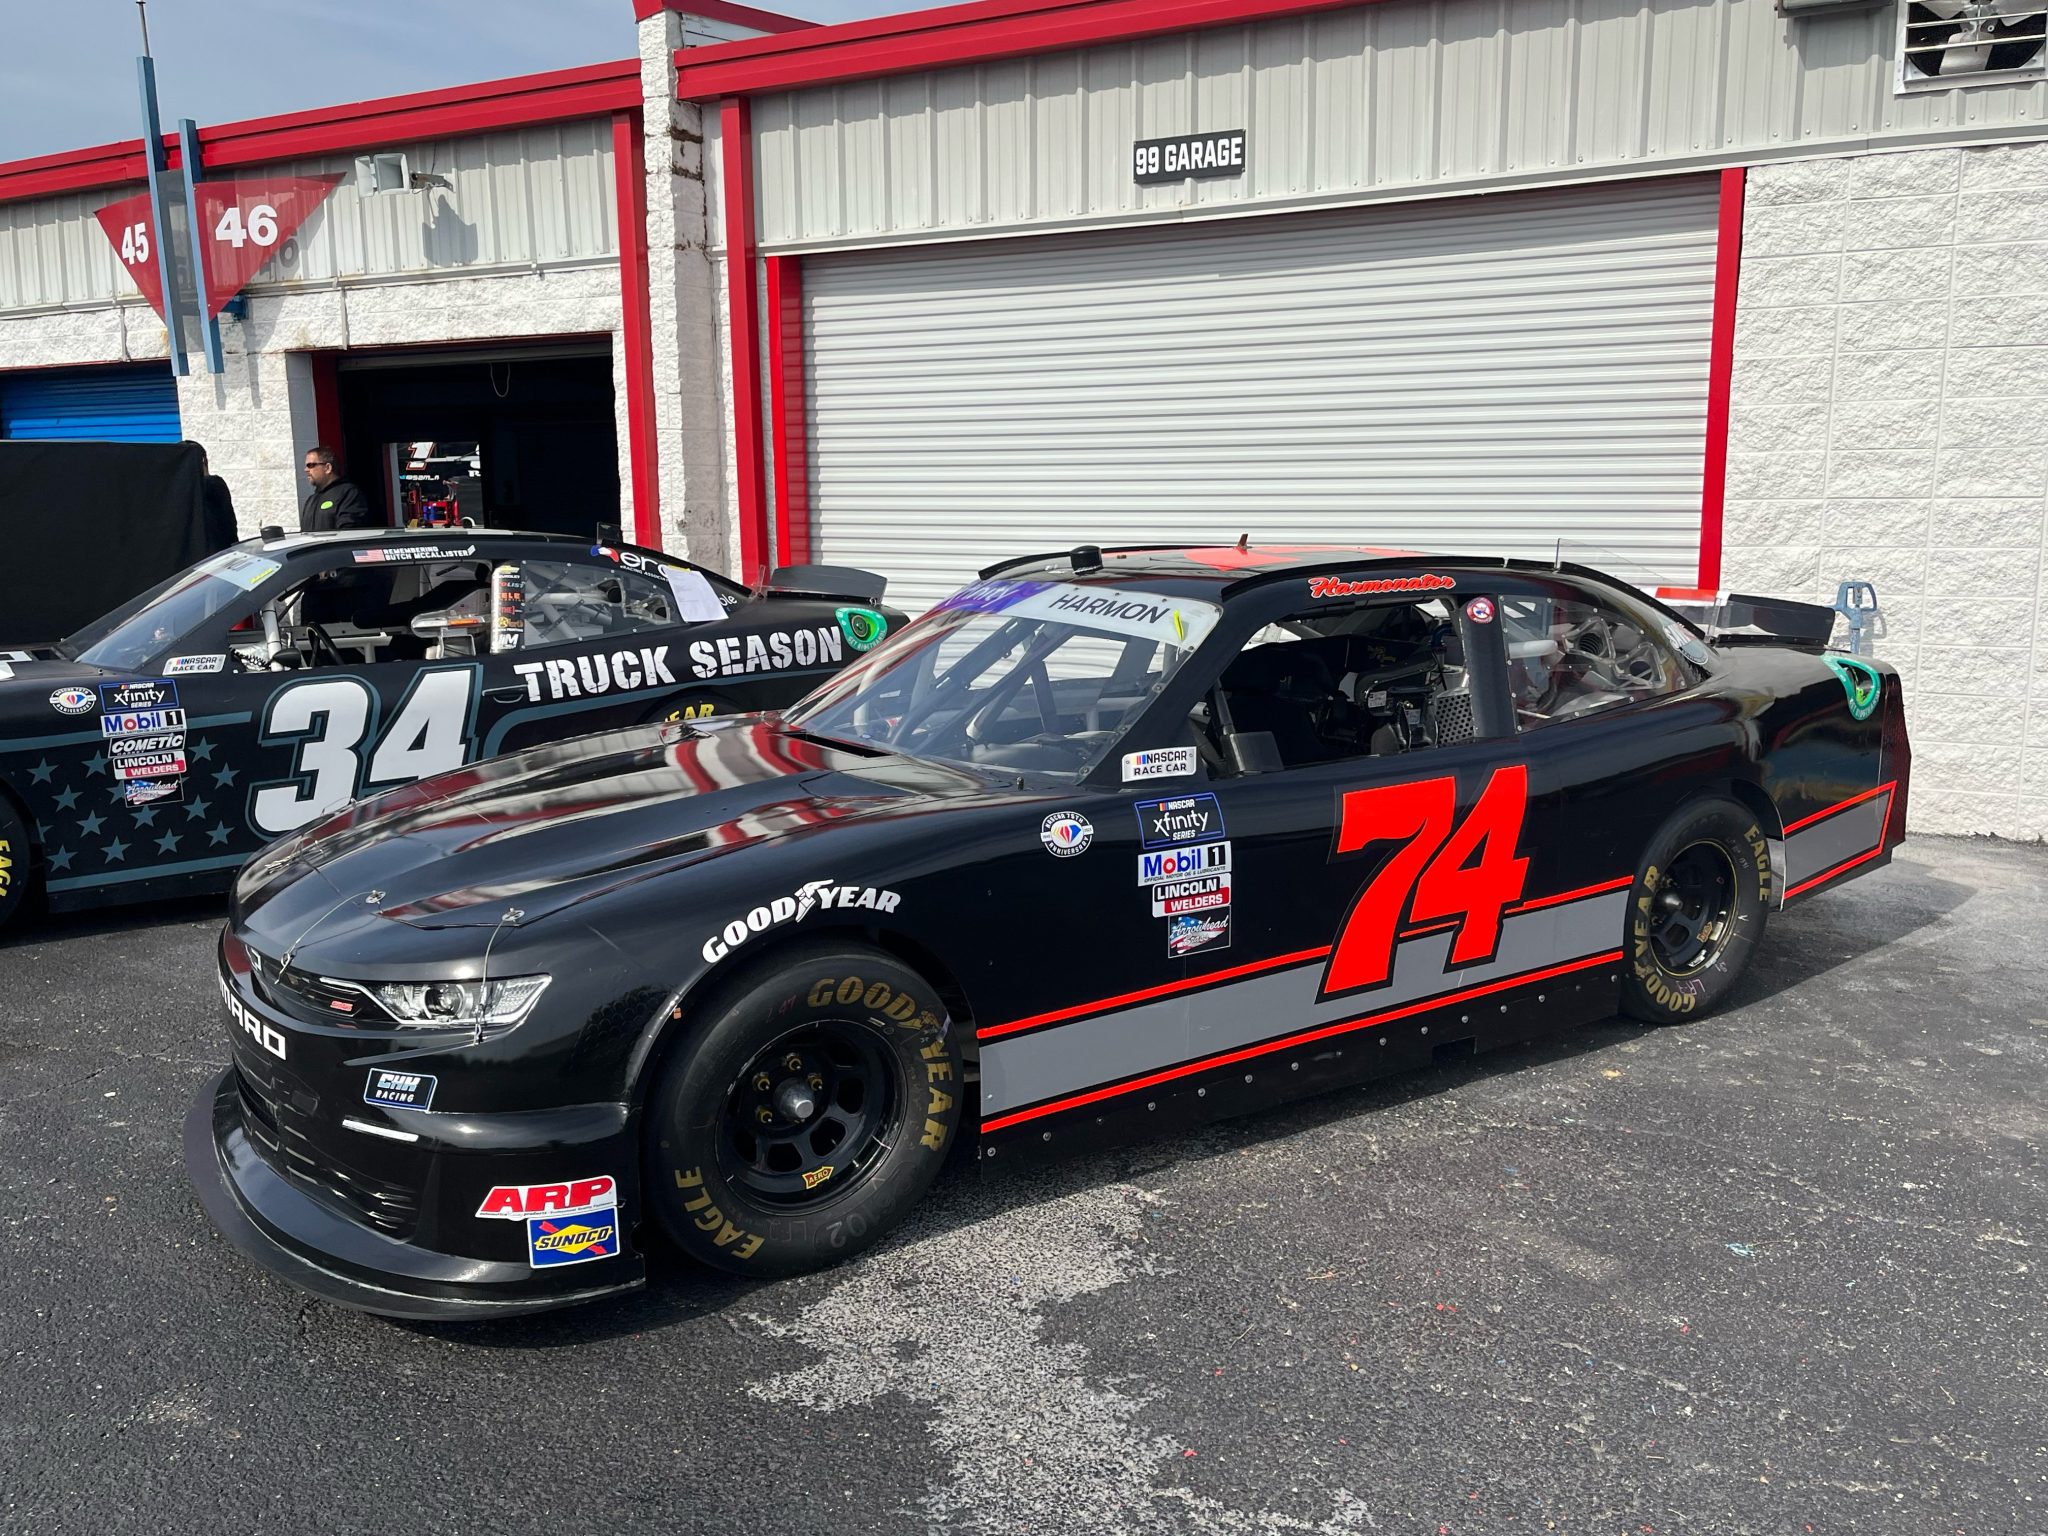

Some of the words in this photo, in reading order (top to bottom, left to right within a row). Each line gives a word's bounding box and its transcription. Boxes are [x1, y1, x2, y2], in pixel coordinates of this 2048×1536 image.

[1136, 146, 1159, 175] 99
[1165, 137, 1242, 172] GARAGE
[215, 205, 278, 248] 46
[122, 222, 149, 265] 45
[383, 546, 439, 555] REMEMBERING
[385, 553, 412, 561] BUTCH
[413, 549, 469, 559] MCCALLISTER
[1308, 573, 1456, 598] Harmonator
[1048, 594, 1170, 624] HARMON
[184, 656, 217, 665] NASCAR
[513, 646, 677, 702] TRUCK
[690, 625, 844, 680] SEASON
[129, 682, 154, 690] NASCAR
[114, 689, 165, 706] xfinity
[104, 712, 161, 733] Mobil
[111, 735, 183, 754] COMETIC
[255, 669, 472, 832] 34
[117, 754, 173, 769] LINCOLN
[1147, 750, 1187, 764] NASCAR
[130, 764, 179, 777] WELDERS
[1134, 765, 1163, 776] RACE
[1166, 763, 1187, 772] CAR
[1168, 799, 1195, 810] NASCAR
[1153, 810, 1208, 837] xfinity
[1048, 835, 1089, 856] ANNIVERSARY
[1172, 830, 1196, 841] SERIES
[1143, 849, 1201, 878] Mobil
[1744, 823, 1771, 902] EAGLE
[1157, 878, 1218, 900] LINCOLN
[1324, 764, 1529, 994] 74
[1170, 894, 1223, 911] WELDERS
[1169, 914, 1229, 939] Arrowhead
[375, 1090, 415, 1102] RACING
[808, 1168, 829, 1184] AERO
[481, 1177, 613, 1212] ARP
[674, 1166, 765, 1259] EAGLE
[539, 1227, 610, 1249] SUNOCO
